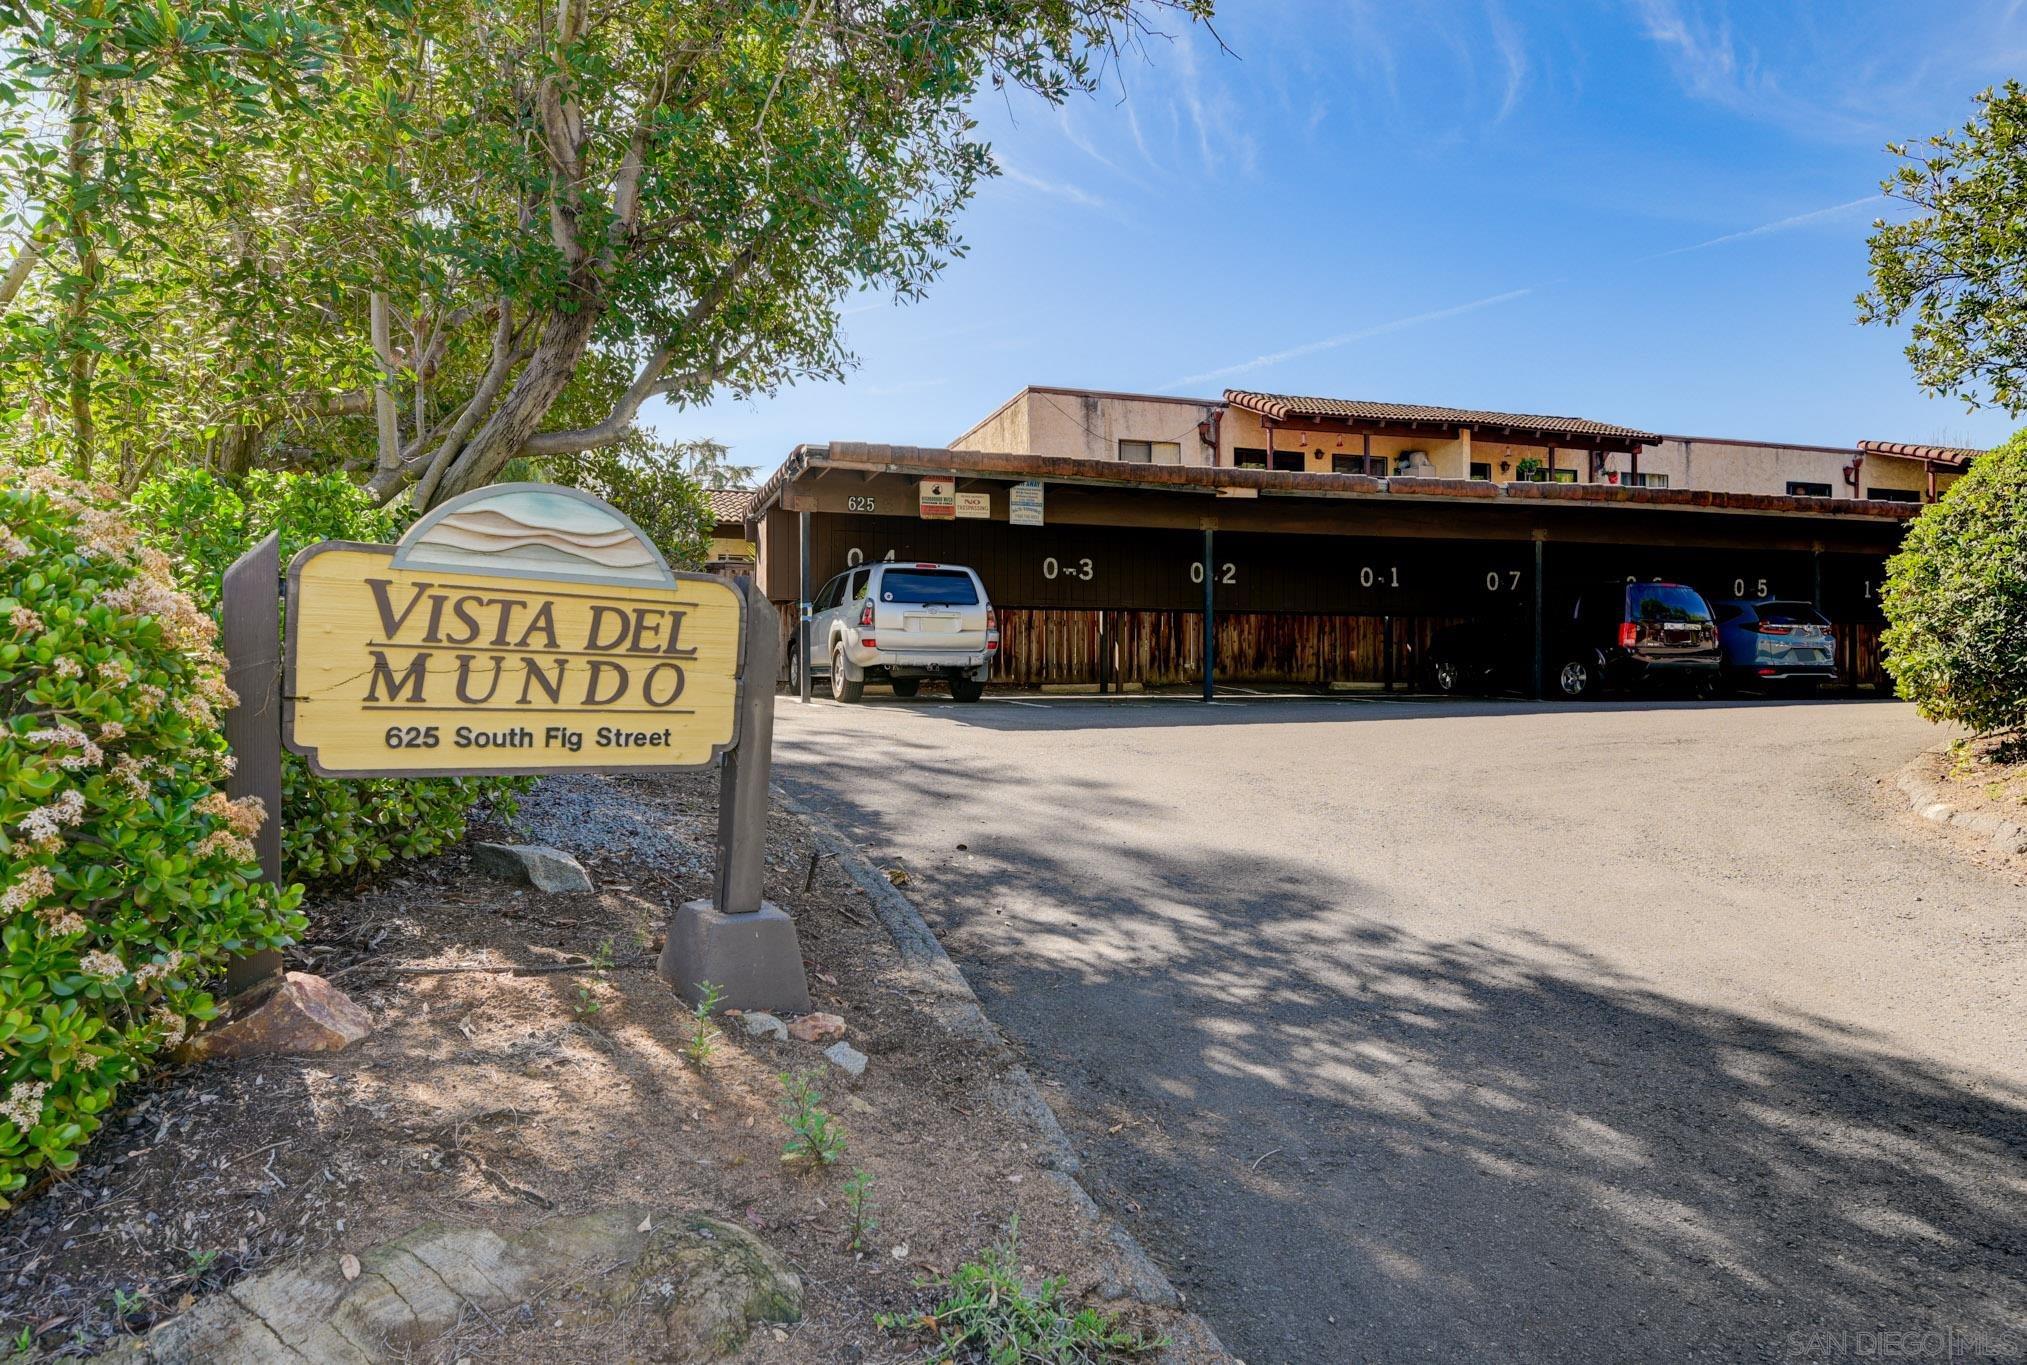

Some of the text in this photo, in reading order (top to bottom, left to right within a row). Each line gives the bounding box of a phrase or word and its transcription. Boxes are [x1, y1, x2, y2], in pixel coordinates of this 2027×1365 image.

[848, 496, 875, 512] 625
[364, 578, 698, 656] VISTA DEL
[363, 650, 686, 707] MUNDO
[385, 726, 673, 752] 625 South Fig Street
